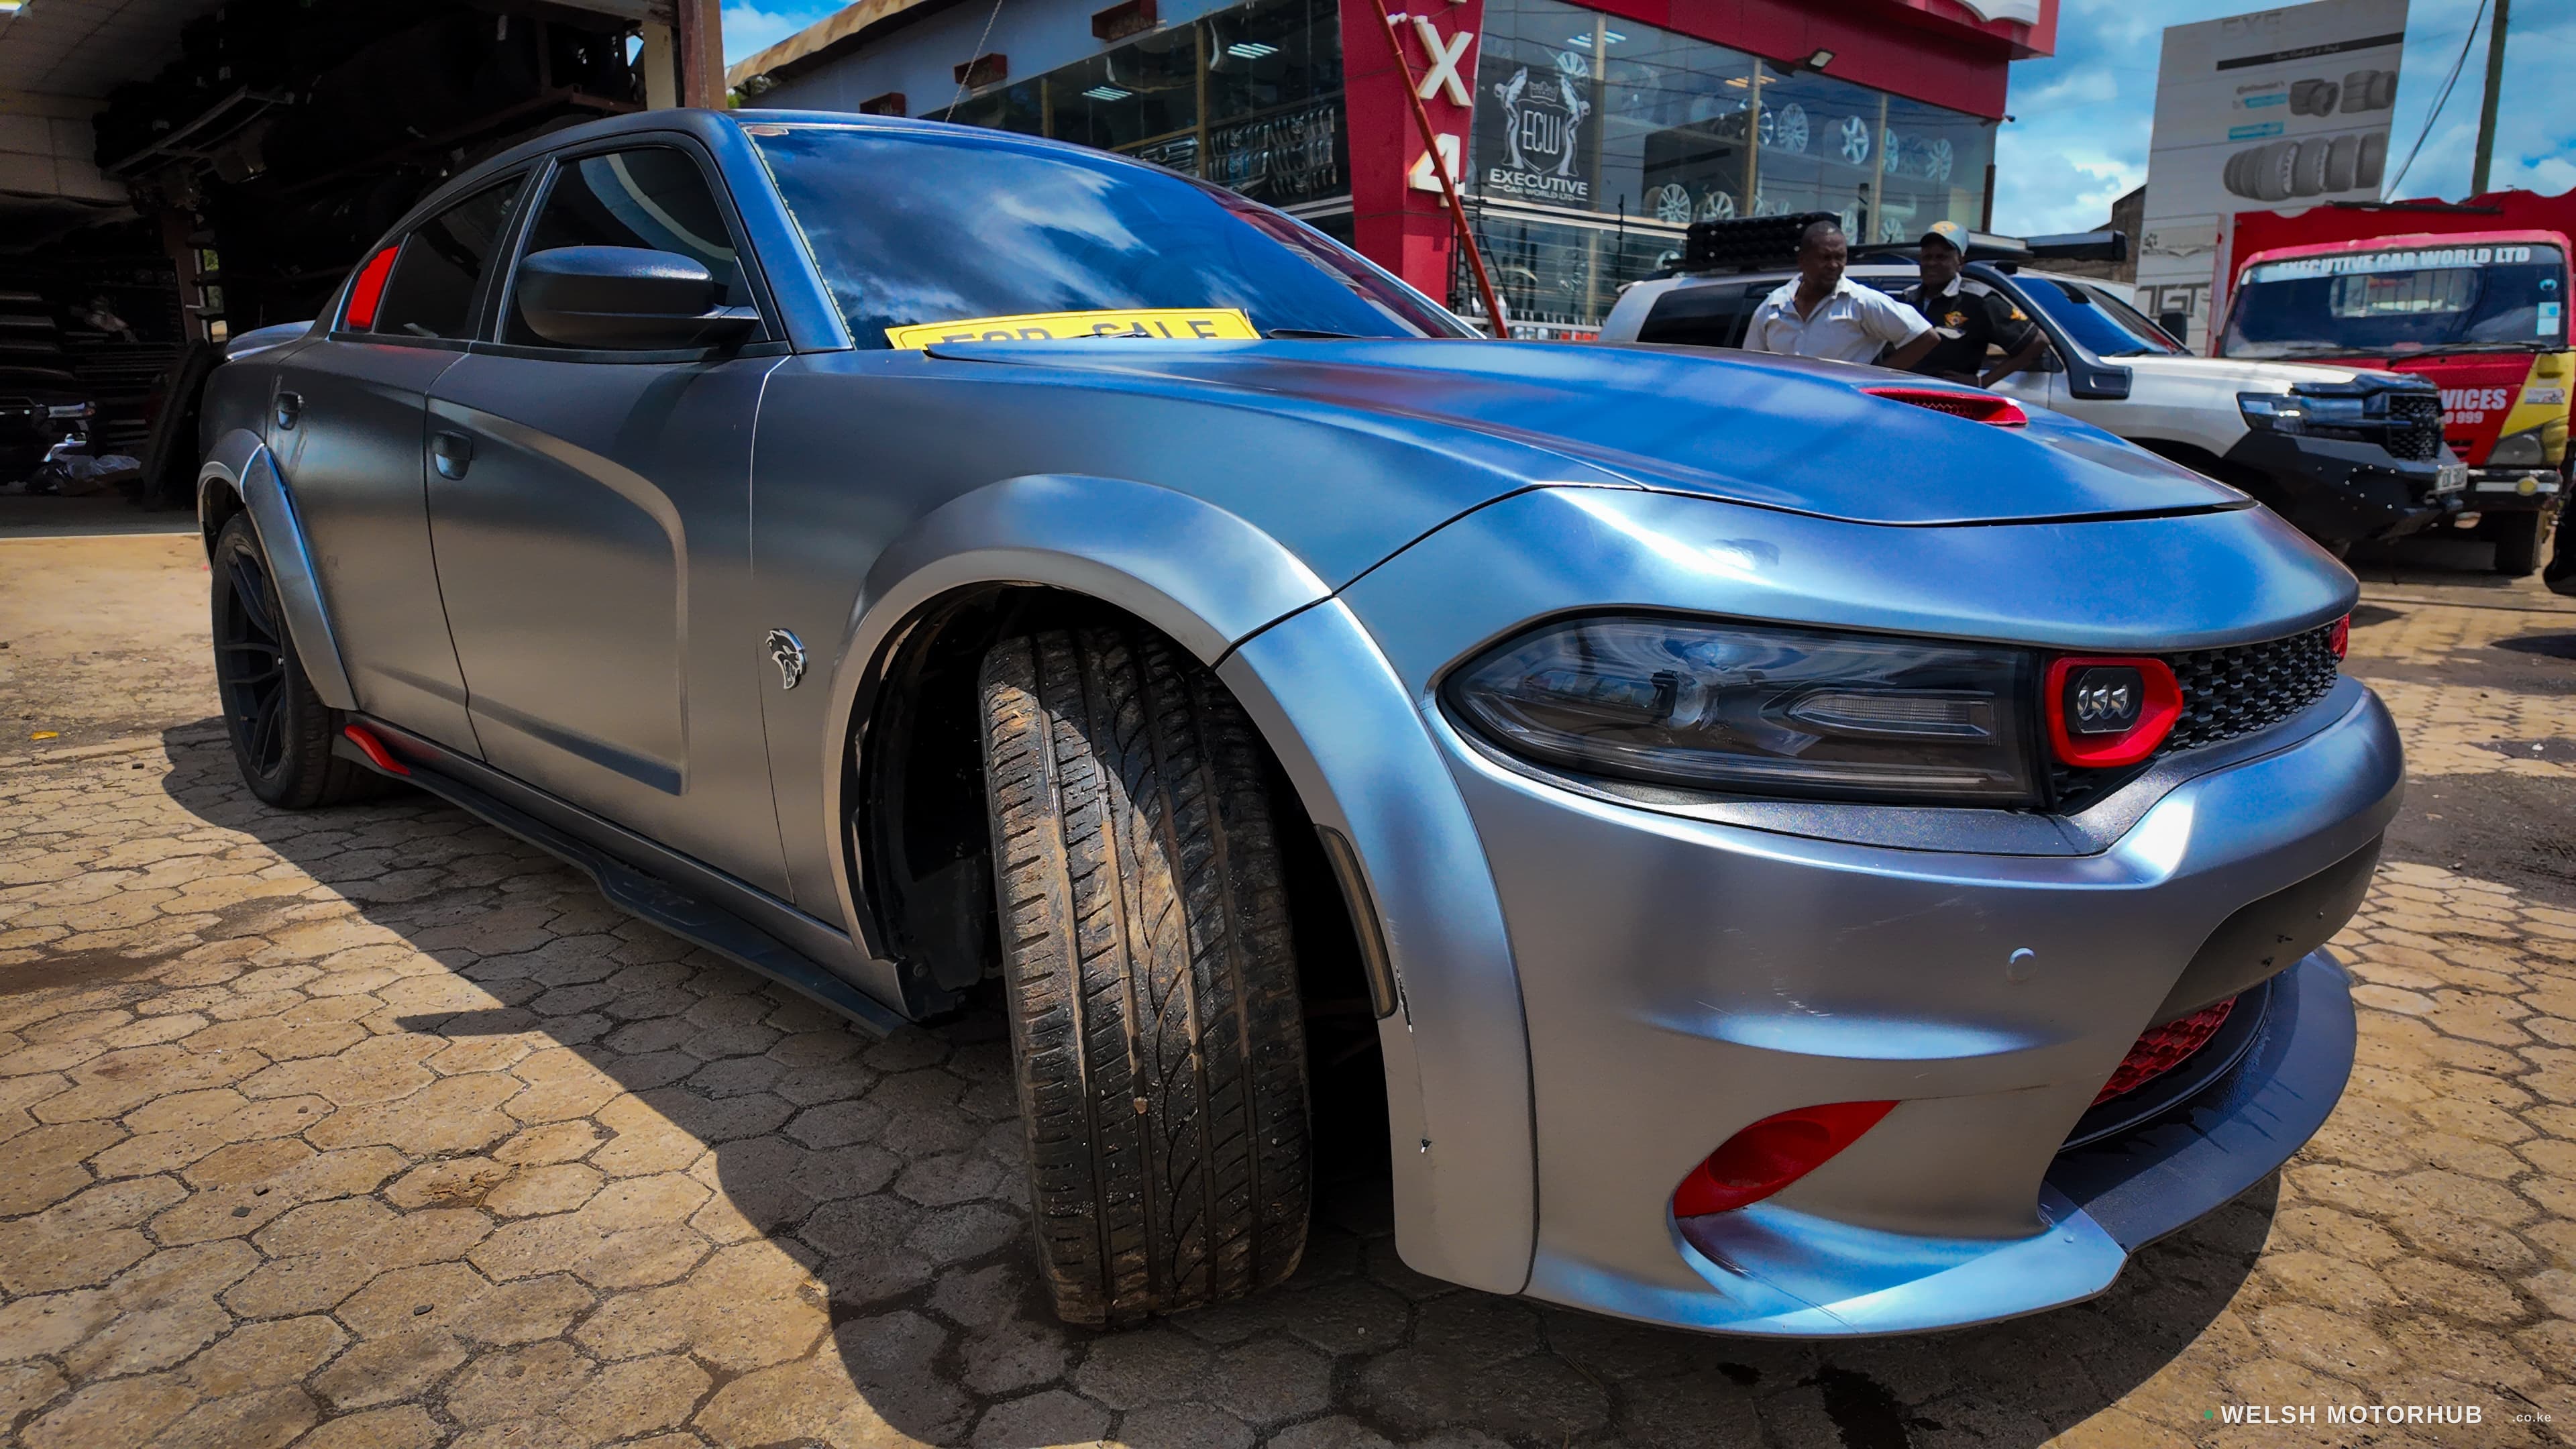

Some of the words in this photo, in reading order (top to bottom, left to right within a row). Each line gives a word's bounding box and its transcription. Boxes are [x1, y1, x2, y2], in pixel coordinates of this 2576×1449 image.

[1521, 110, 1560, 155] ECW
[1489, 168, 1588, 195] EXECUTIVE
[1503, 184, 1523, 194] CAR
[1525, 189, 1558, 199] WORLD
[2377, 252, 2416, 268] CAR
[2419, 248, 2491, 266] WORLD
[2495, 247, 2530, 263] LTD
[2442, 388, 2508, 410] VICES
[2455, 411, 2485, 424] 999
